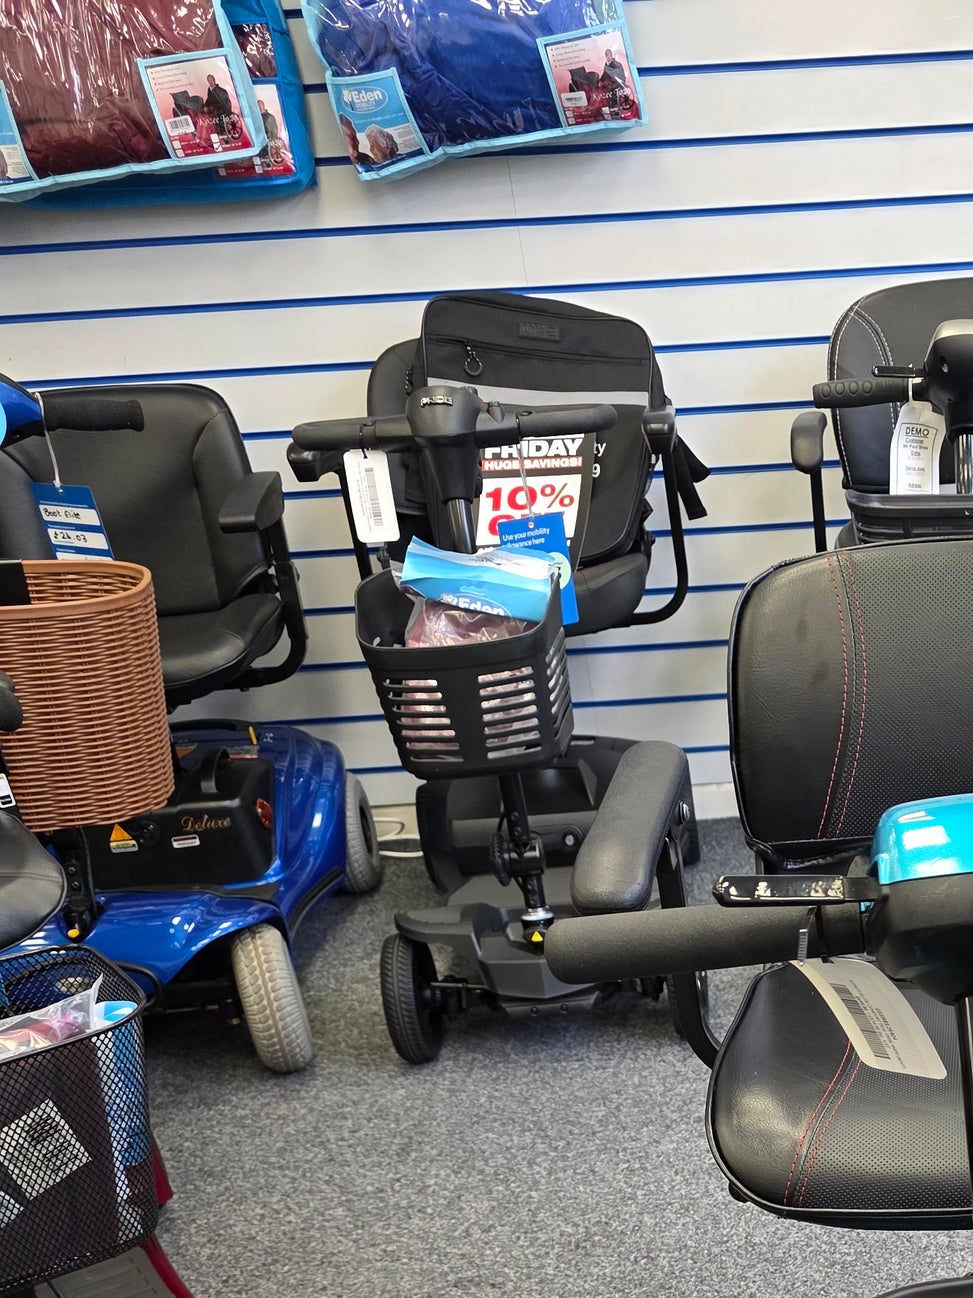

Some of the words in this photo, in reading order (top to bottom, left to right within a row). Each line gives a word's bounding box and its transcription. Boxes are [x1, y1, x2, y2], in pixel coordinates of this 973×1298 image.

[352, 90, 383, 103] Eden
[420, 395, 454, 407] PRIDE
[905, 426, 930, 437] DEMO
[484, 438, 583, 459] FRIDAY
[484, 459, 520, 471] HUGE
[485, 482, 575, 512] 10%
[502, 533, 514, 542] Use
[513, 531, 527, 543] your
[526, 527, 551, 538] mobility
[531, 537, 545, 546] here
[458, 597, 505, 616] Eden
[181, 814, 233, 832] Deluxe
